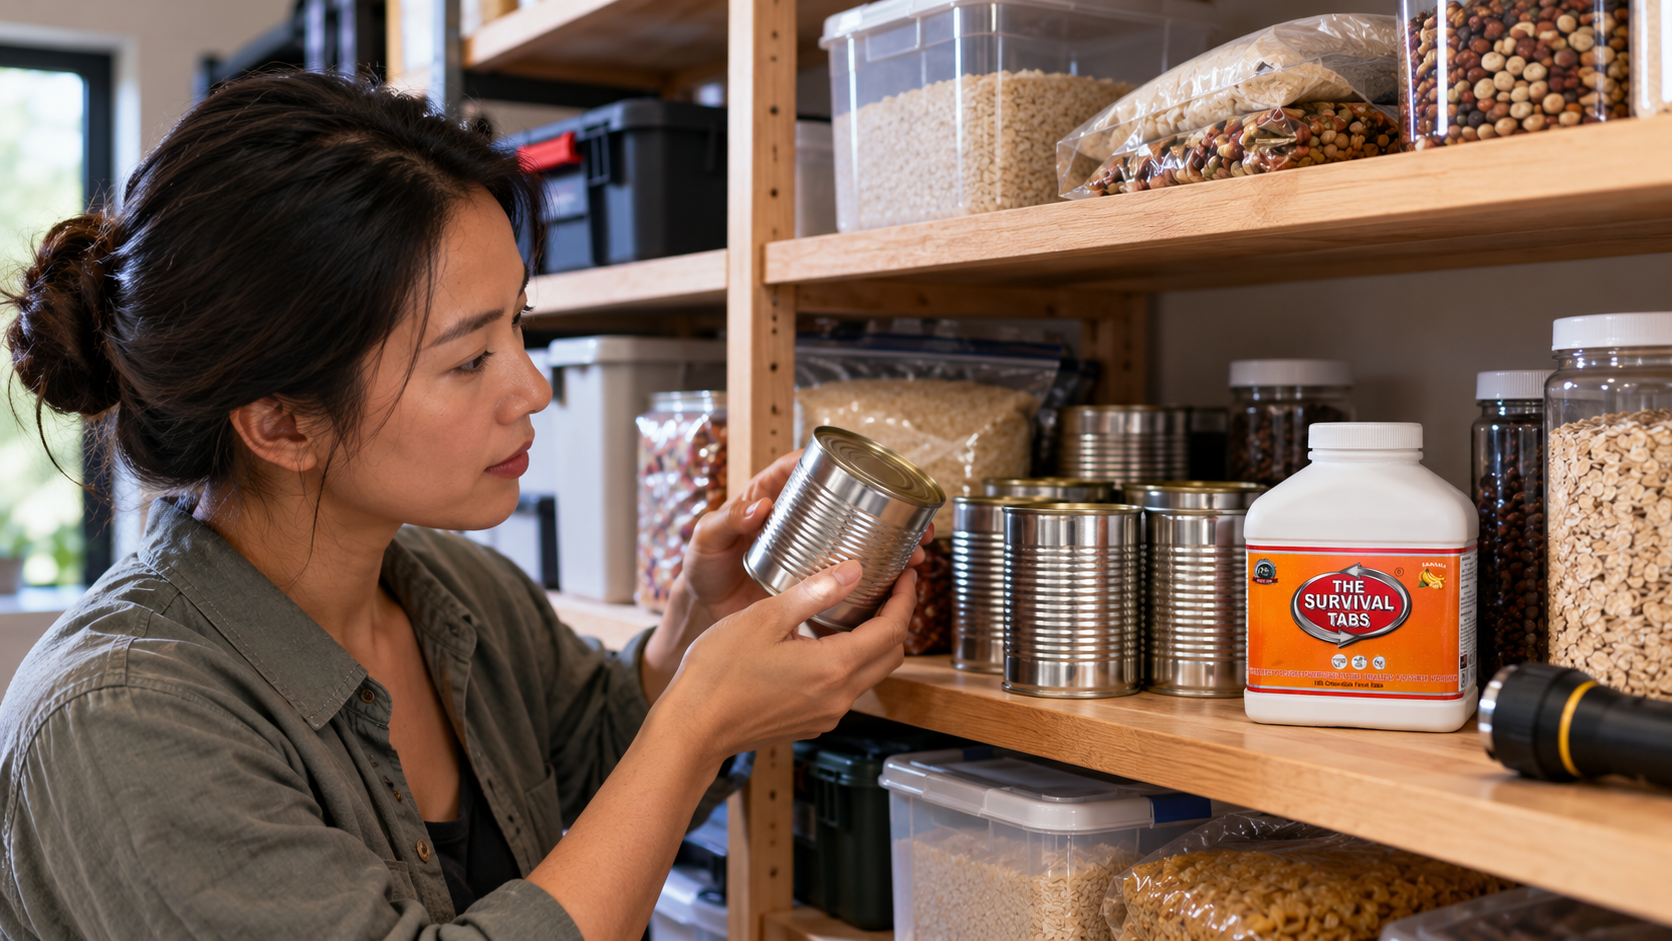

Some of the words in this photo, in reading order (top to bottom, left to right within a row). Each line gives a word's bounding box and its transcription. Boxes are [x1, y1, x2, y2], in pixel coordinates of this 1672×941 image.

[1332, 580, 1365, 593] THE
[1304, 594, 1395, 611] SURVIVAL
[1327, 612, 1371, 628] TABS
